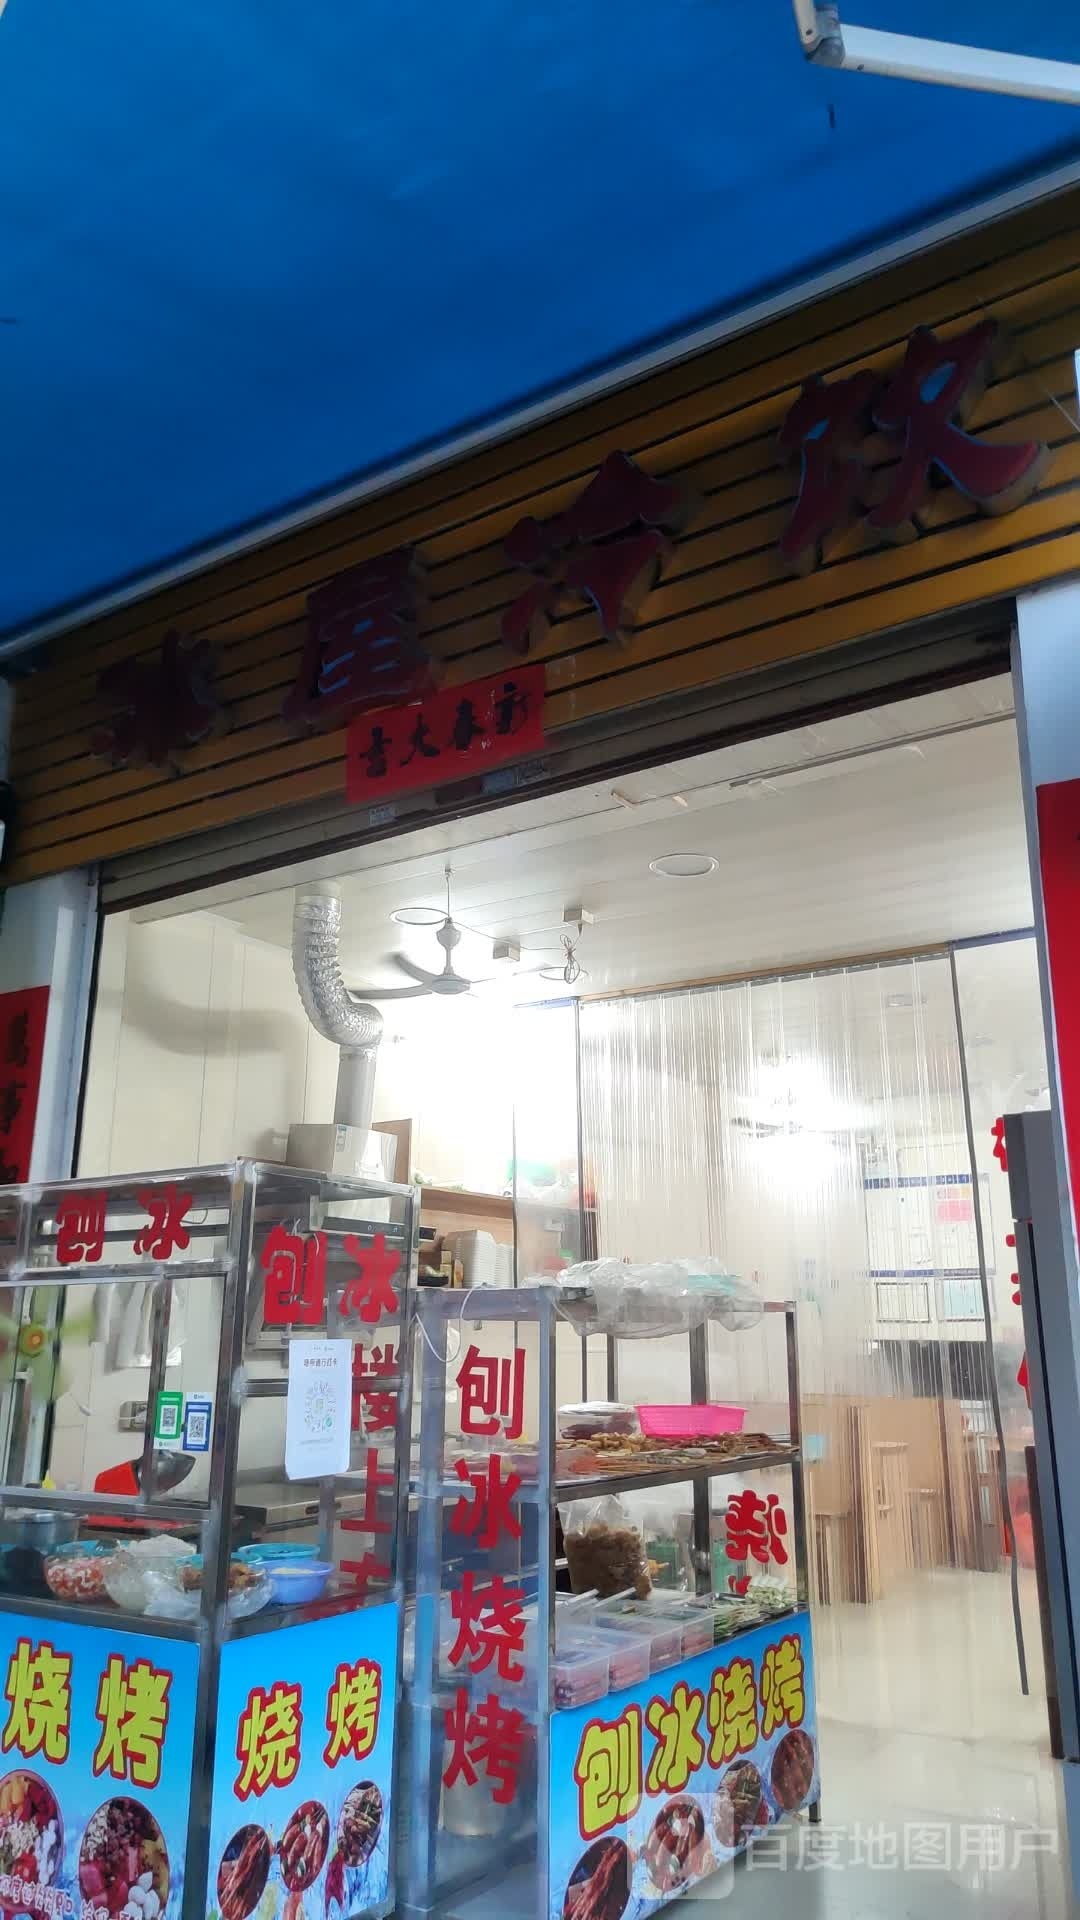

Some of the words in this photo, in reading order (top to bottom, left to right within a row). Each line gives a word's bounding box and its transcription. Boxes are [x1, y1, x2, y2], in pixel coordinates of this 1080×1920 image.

[56, 1183, 196, 1263] 刨冰
[261, 1225, 402, 1326] 刨冰
[443, 1344, 526, 1805] 刨冰烧烤
[2, 1638, 172, 1789] 烧烤
[234, 1658, 383, 1802] 烧烤
[575, 1633, 807, 1842] 刨冰烧烤
